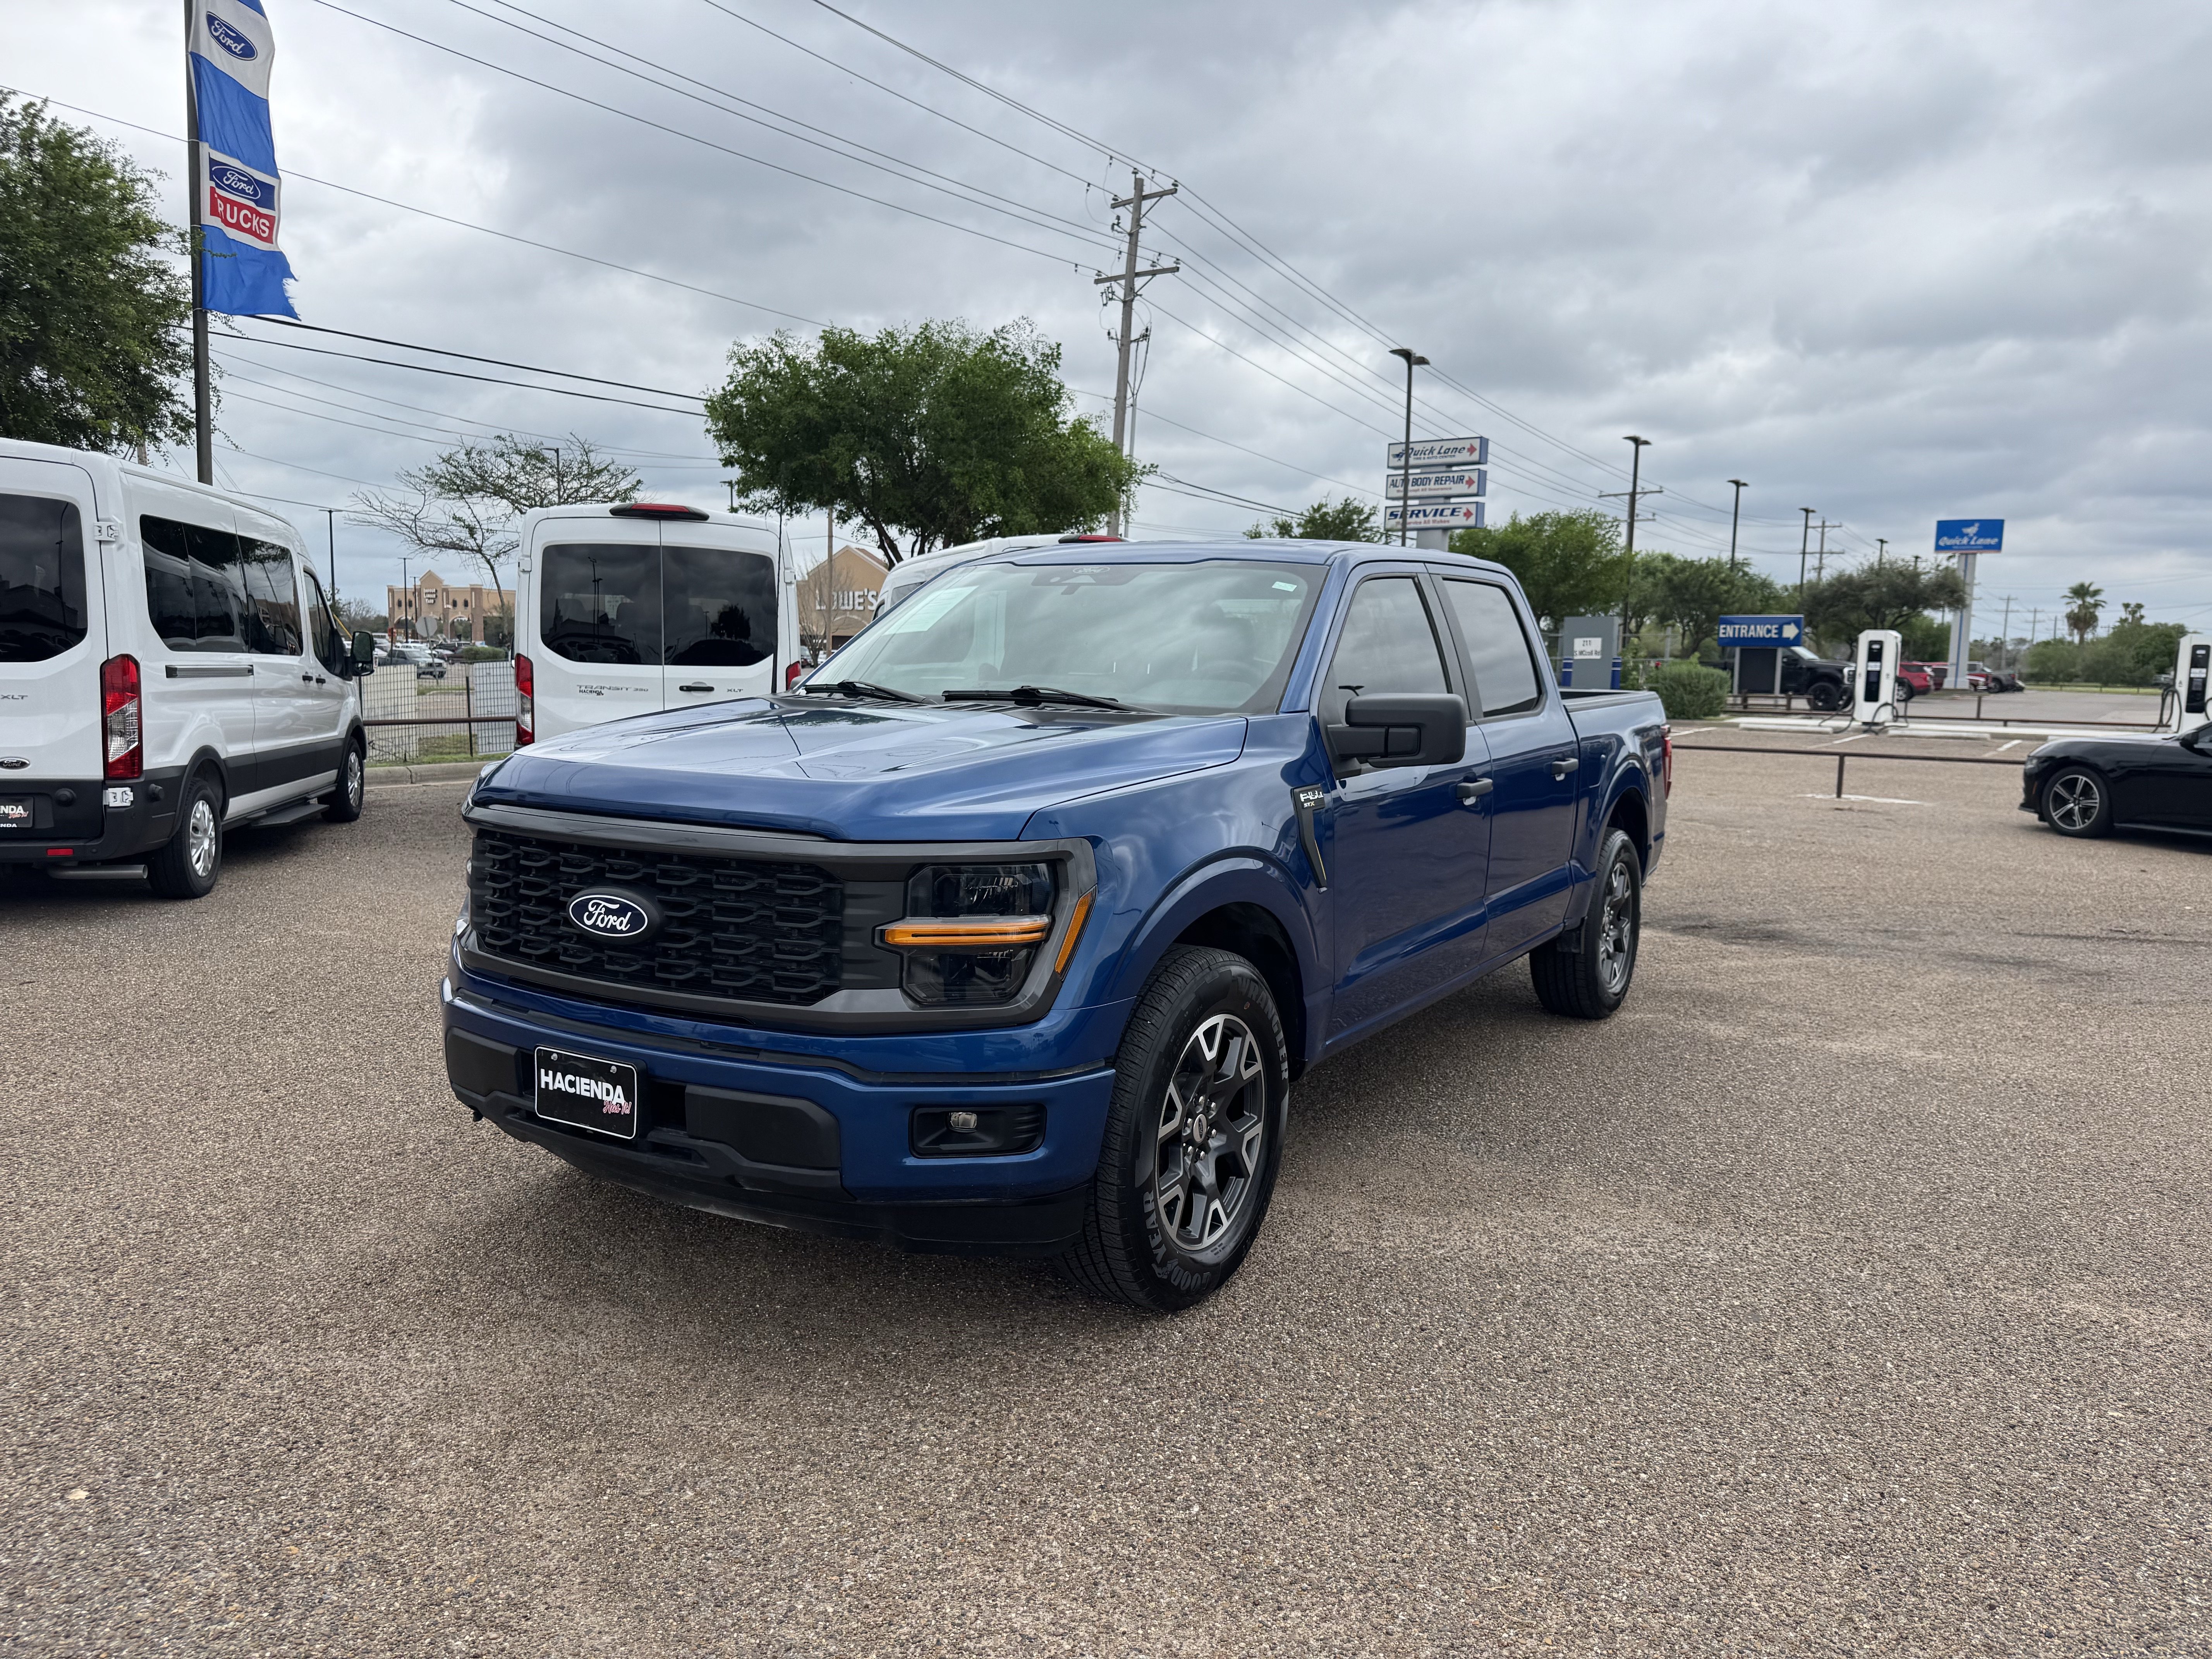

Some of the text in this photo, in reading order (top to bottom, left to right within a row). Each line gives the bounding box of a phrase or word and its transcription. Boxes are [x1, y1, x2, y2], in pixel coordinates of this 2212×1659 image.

[210, 20, 243, 55] Ford
[223, 170, 254, 195] Ford
[214, 193, 270, 238] RUCKS
[1437, 446, 1465, 455] Lane
[1389, 475, 1465, 488] AUT BODY REPAIR
[1719, 624, 1779, 638] ENTRANCE
[583, 900, 632, 931] Ford
[540, 1068, 625, 1105] HACIENDA
[603, 1100, 631, 1115] Has It!
